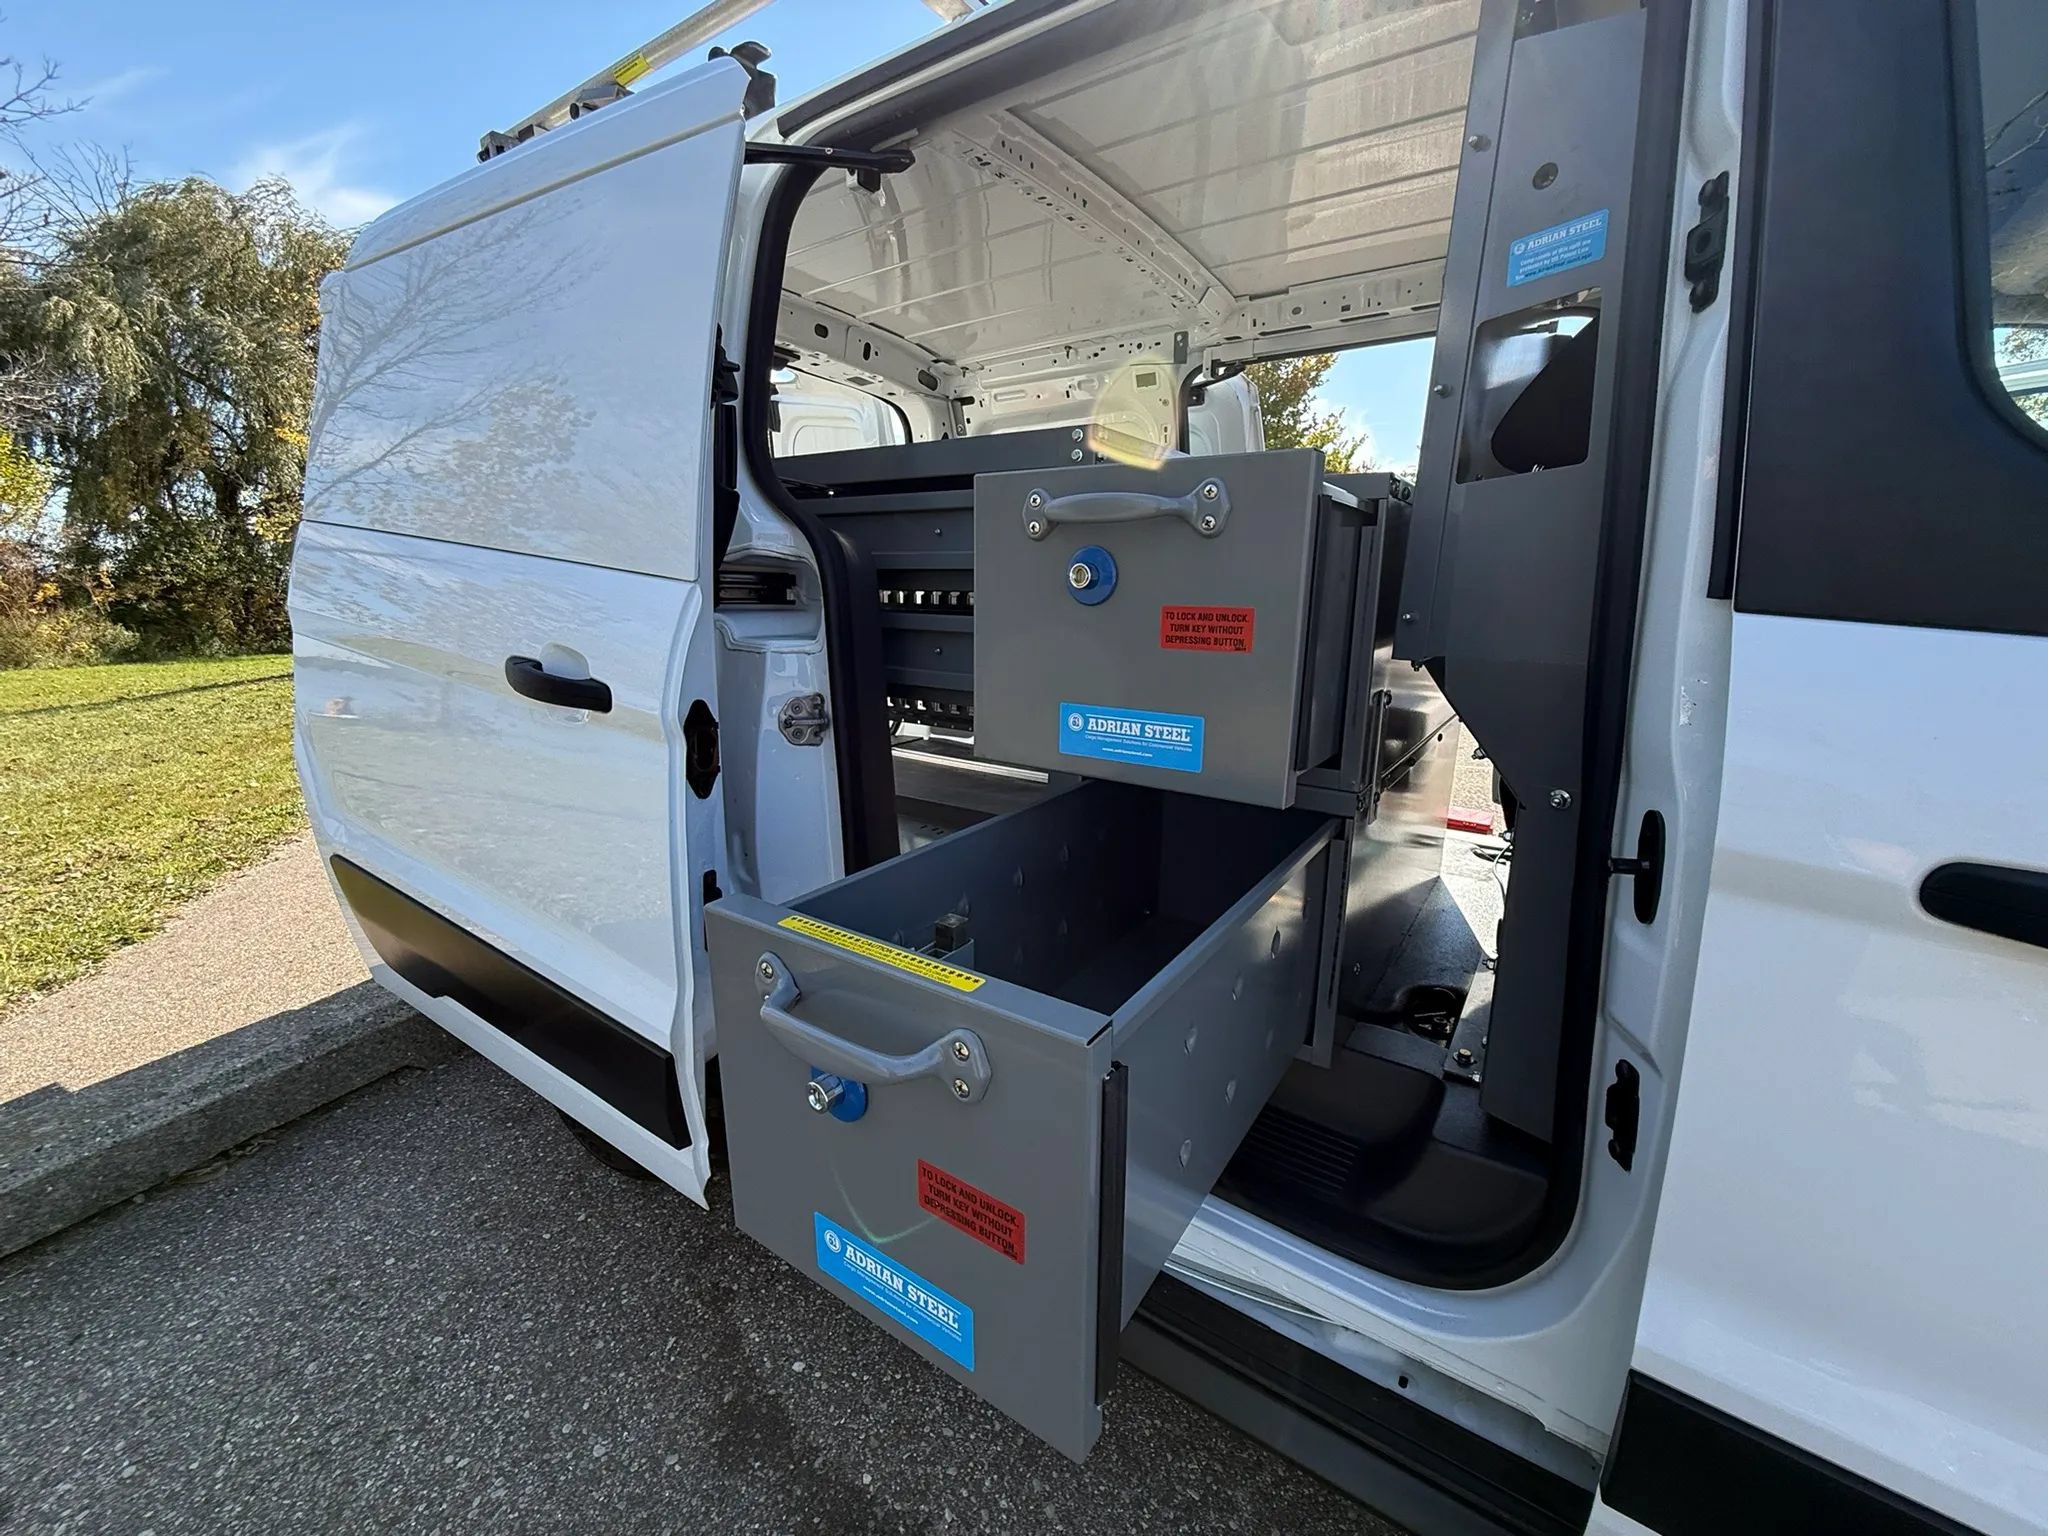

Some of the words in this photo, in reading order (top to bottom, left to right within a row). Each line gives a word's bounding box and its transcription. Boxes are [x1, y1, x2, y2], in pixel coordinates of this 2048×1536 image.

[1527, 230, 1566, 249] ADRIAN
[1569, 219, 1602, 235] STEEL
[1177, 612, 1195, 620] LOCK
[1198, 613, 1214, 621] AND
[1165, 635, 1211, 645] DEPRESSING
[1170, 624, 1190, 632] TURN
[1192, 624, 1206, 632] KEY
[1208, 626, 1244, 634] WITHOUT
[1088, 717, 1141, 735] ADRIAN
[861, 941, 894, 954] CAUTION
[922, 1167, 933, 1180] TO
[935, 1174, 957, 1193] LOCK
[959, 1188, 977, 1204] AND
[924, 1195, 976, 1231] DEPRESSING
[929, 1184, 950, 1204] TURN
[953, 1197, 969, 1212] KEY
[972, 1207, 1013, 1238] WITHOUT
[845, 1244, 903, 1292] ADRIAN
